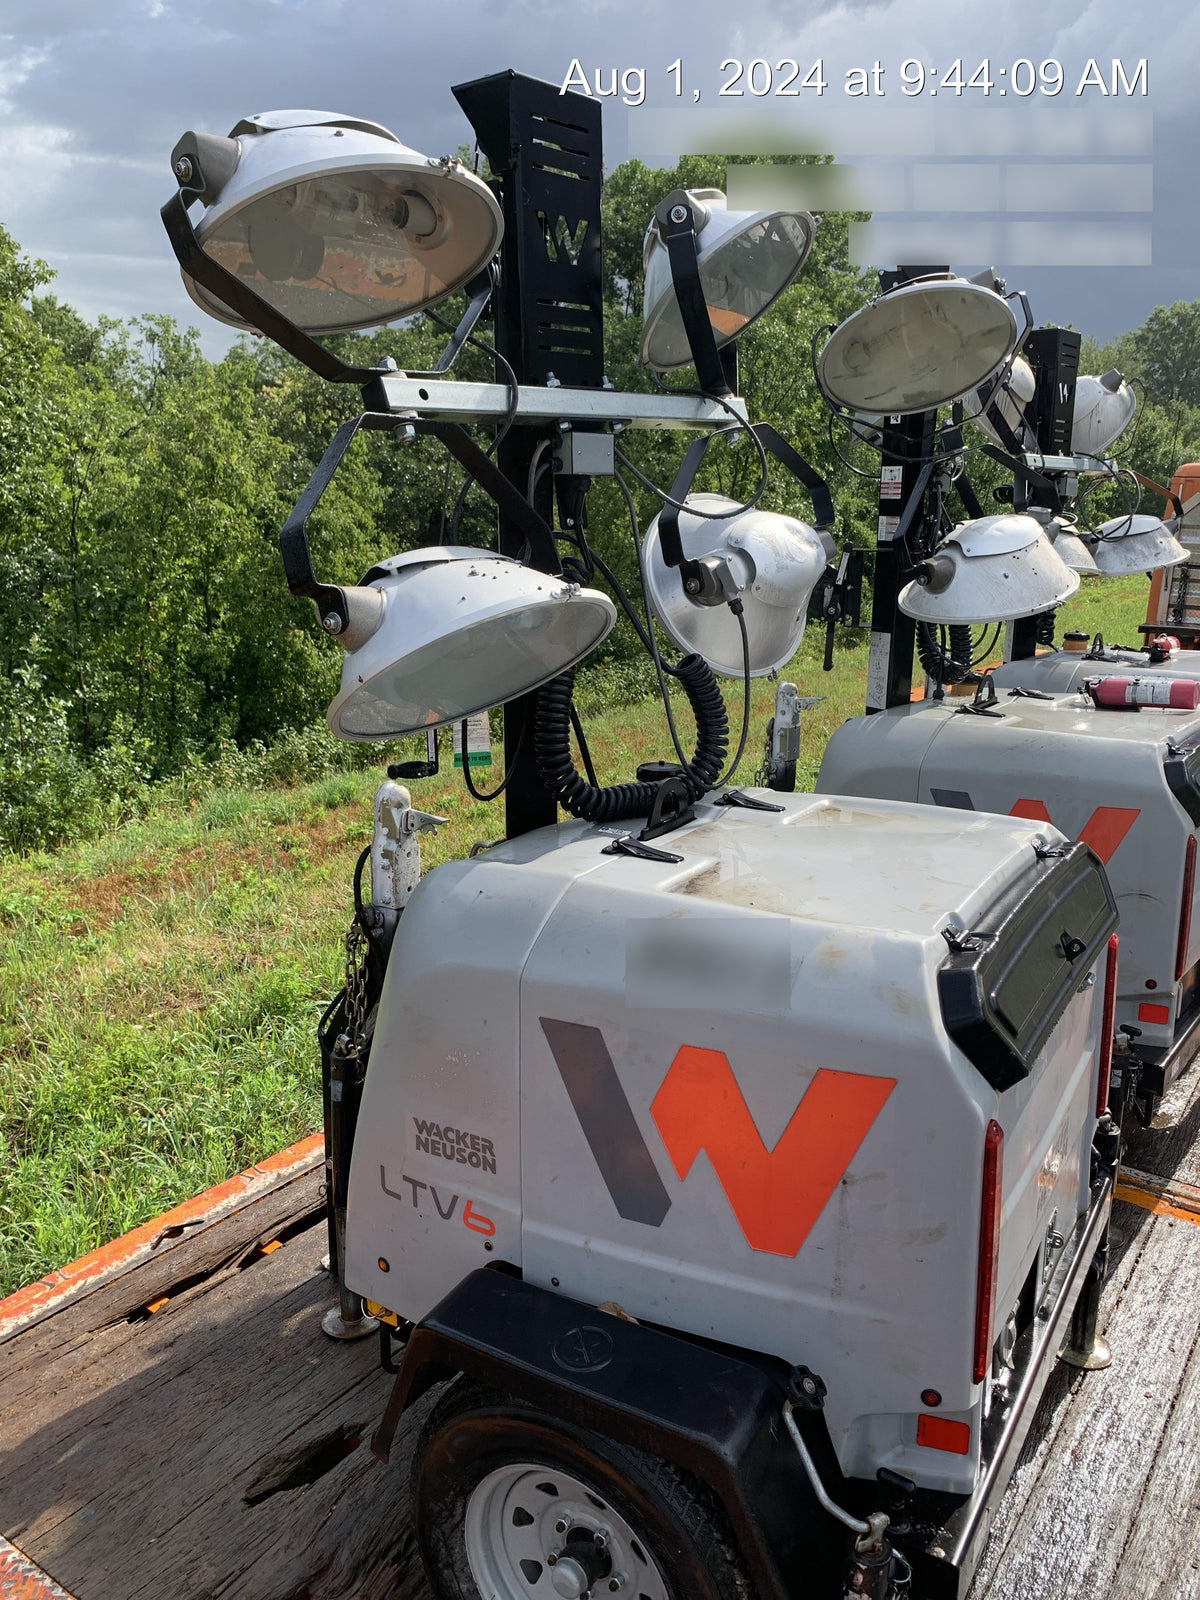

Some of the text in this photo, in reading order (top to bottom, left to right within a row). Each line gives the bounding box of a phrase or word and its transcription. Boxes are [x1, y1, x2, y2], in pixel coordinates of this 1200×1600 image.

[535, 209, 591, 267] W
[412, 1116, 496, 1157] WACKER
[415, 1134, 497, 1175] NEUSON
[539, 1016, 898, 1258] W
[380, 1164, 496, 1237] LTV6
